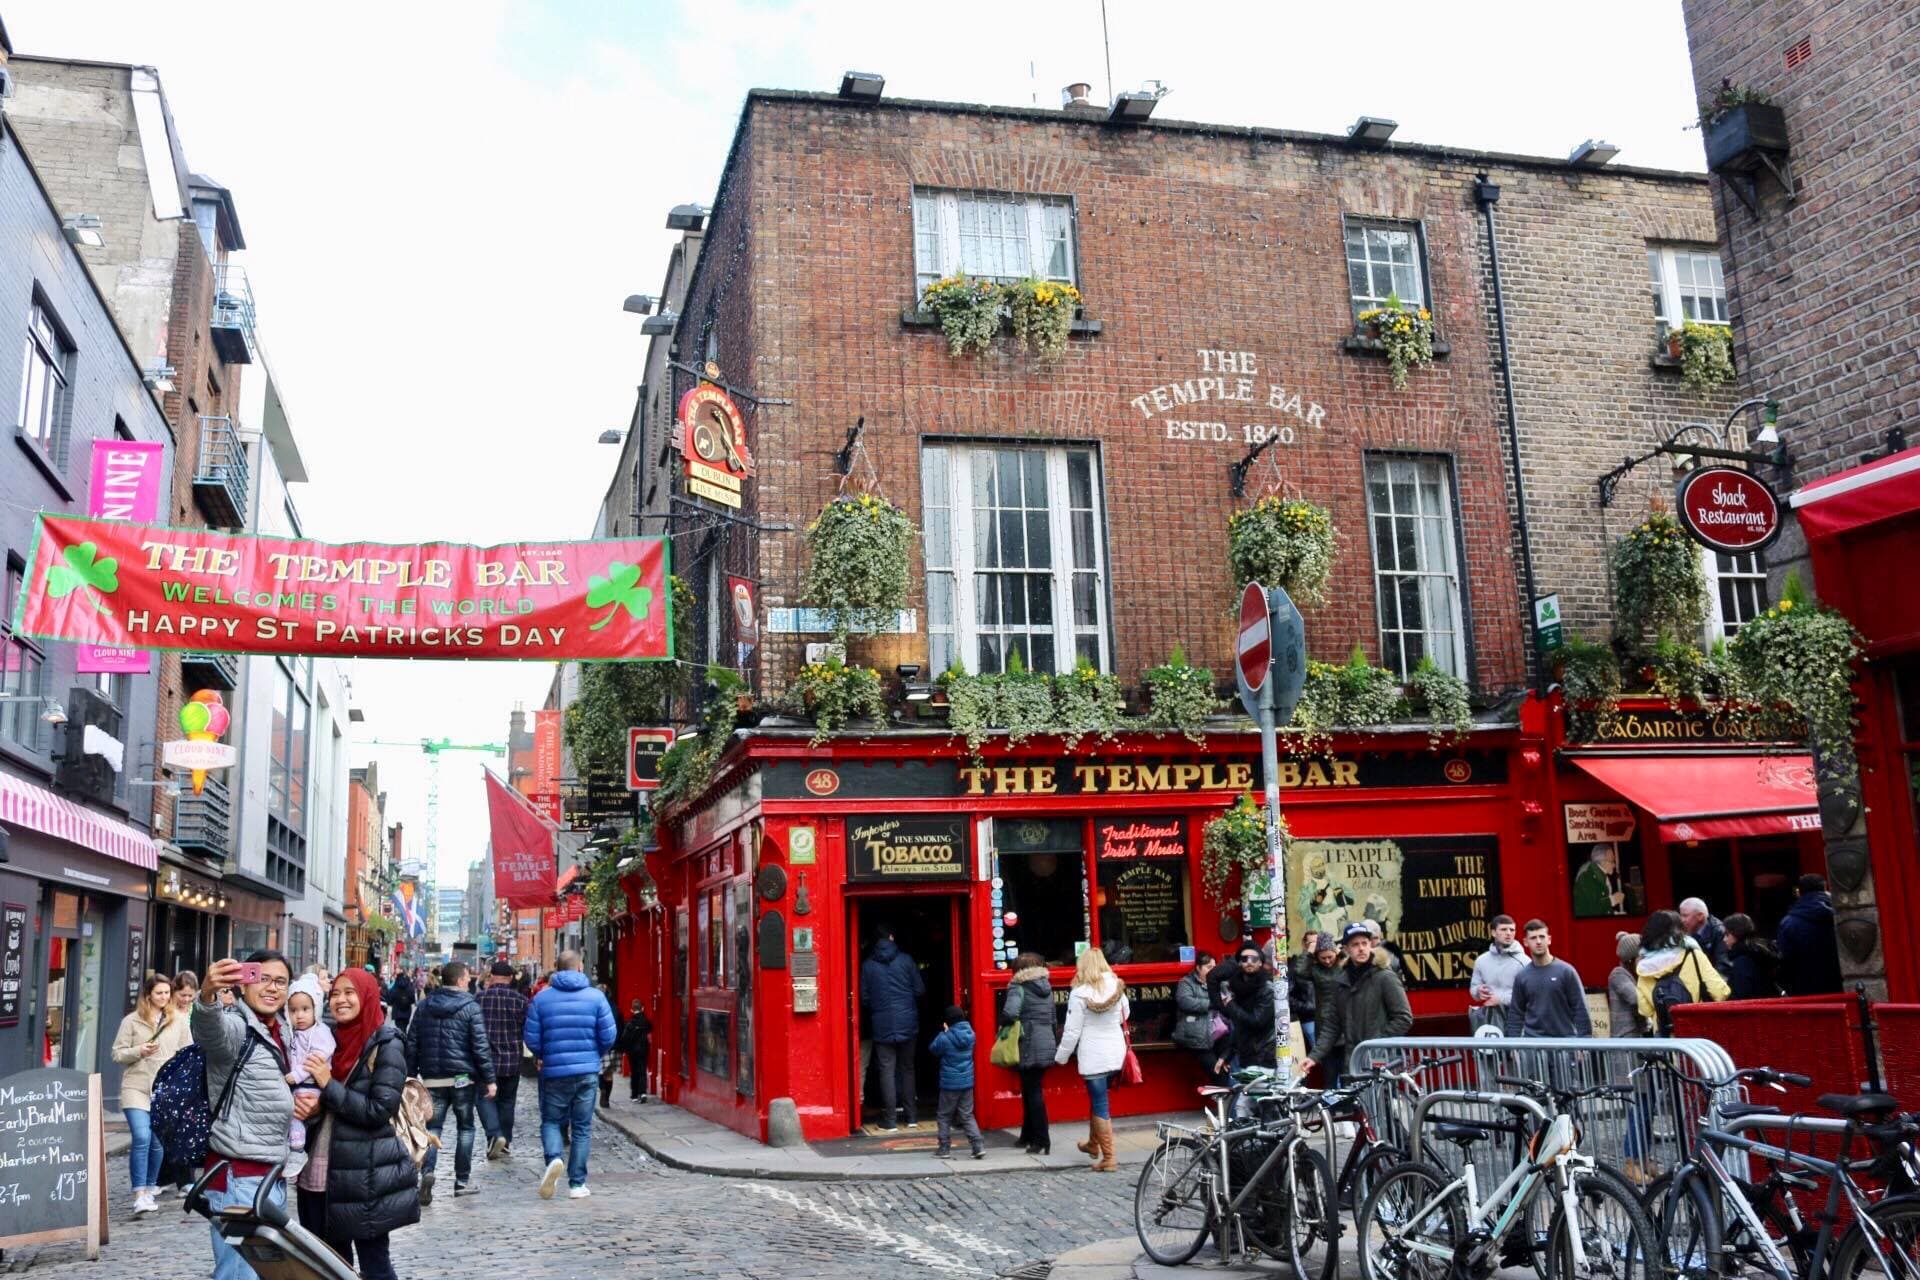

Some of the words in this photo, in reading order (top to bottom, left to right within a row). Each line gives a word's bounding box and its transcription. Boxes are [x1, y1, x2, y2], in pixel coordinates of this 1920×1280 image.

[1197, 350, 1258, 374] THE
[1130, 377, 1254, 419] TEMPLE
[1266, 384, 1326, 429] BAR
[696, 389, 732, 415] TEMPLE
[731, 416, 743, 445] BAR
[1166, 420, 1233, 442] ESTD.
[102, 451, 149, 521] NINE
[695, 483, 711, 496] LIVE
[1712, 482, 1748, 508] Shack
[1698, 508, 1767, 525] Restaurant
[141, 541, 240, 576] THE
[268, 553, 452, 588] TEMPLE
[476, 560, 569, 587] BAR
[162, 581, 338, 610] WELCOMES
[359, 597, 417, 614] THE
[431, 599, 534, 615] WORLD
[127, 610, 240, 637] HAPPY
[256, 617, 299, 640] ST
[316, 620, 484, 645] PATRICK'S
[500, 624, 566, 646] DAY
[93, 647, 117, 658] CLOUD
[118, 648, 136, 659] NINE
[960, 767, 1058, 794] THE
[1075, 764, 1255, 792] TEMPLE
[1278, 761, 1361, 787] BAR
[1448, 764, 1465, 778] 48
[811, 773, 833, 789] 48
[1568, 807, 1588, 818] Beer
[1590, 806, 1622, 818] Garden
[851, 819, 900, 841] Importers
[1102, 821, 1180, 841] Traditional
[1568, 819, 1605, 831] Smoking
[1786, 814, 1822, 830] THE
[915, 835, 952, 843] SMOKING
[1577, 832, 1598, 841] Area
[513, 853, 534, 861] THE
[865, 841, 953, 871] TOBACCO
[1102, 841, 1137, 858] Irish
[1143, 840, 1184, 857] Music
[1323, 848, 1398, 864] TEMPLE
[498, 860, 551, 872] TEMPLE
[883, 863, 919, 874] Always
[921, 863, 931, 873] in
[933, 863, 962, 873] Stock
[1117, 866, 1152, 883] TEMPLE
[1154, 868, 1173, 883] BAR
[1346, 864, 1382, 879] BAR
[1455, 856, 1484, 875] THE
[513, 872, 541, 881] BAR
[1418, 877, 1486, 898] EMPEROR
[1470, 899, 1487, 917] OF
[1141, 986, 1171, 999] BAR
[0, 1086, 44, 1105] Mexico
[53, 1080, 88, 1101] Rome
[27, 1106, 54, 1126] Bird
[54, 1101, 88, 1124] Menu
[16, 1136, 26, 1148] 2
[28, 1136, 64, 1146] course
[49, 1146, 84, 1164] Main
